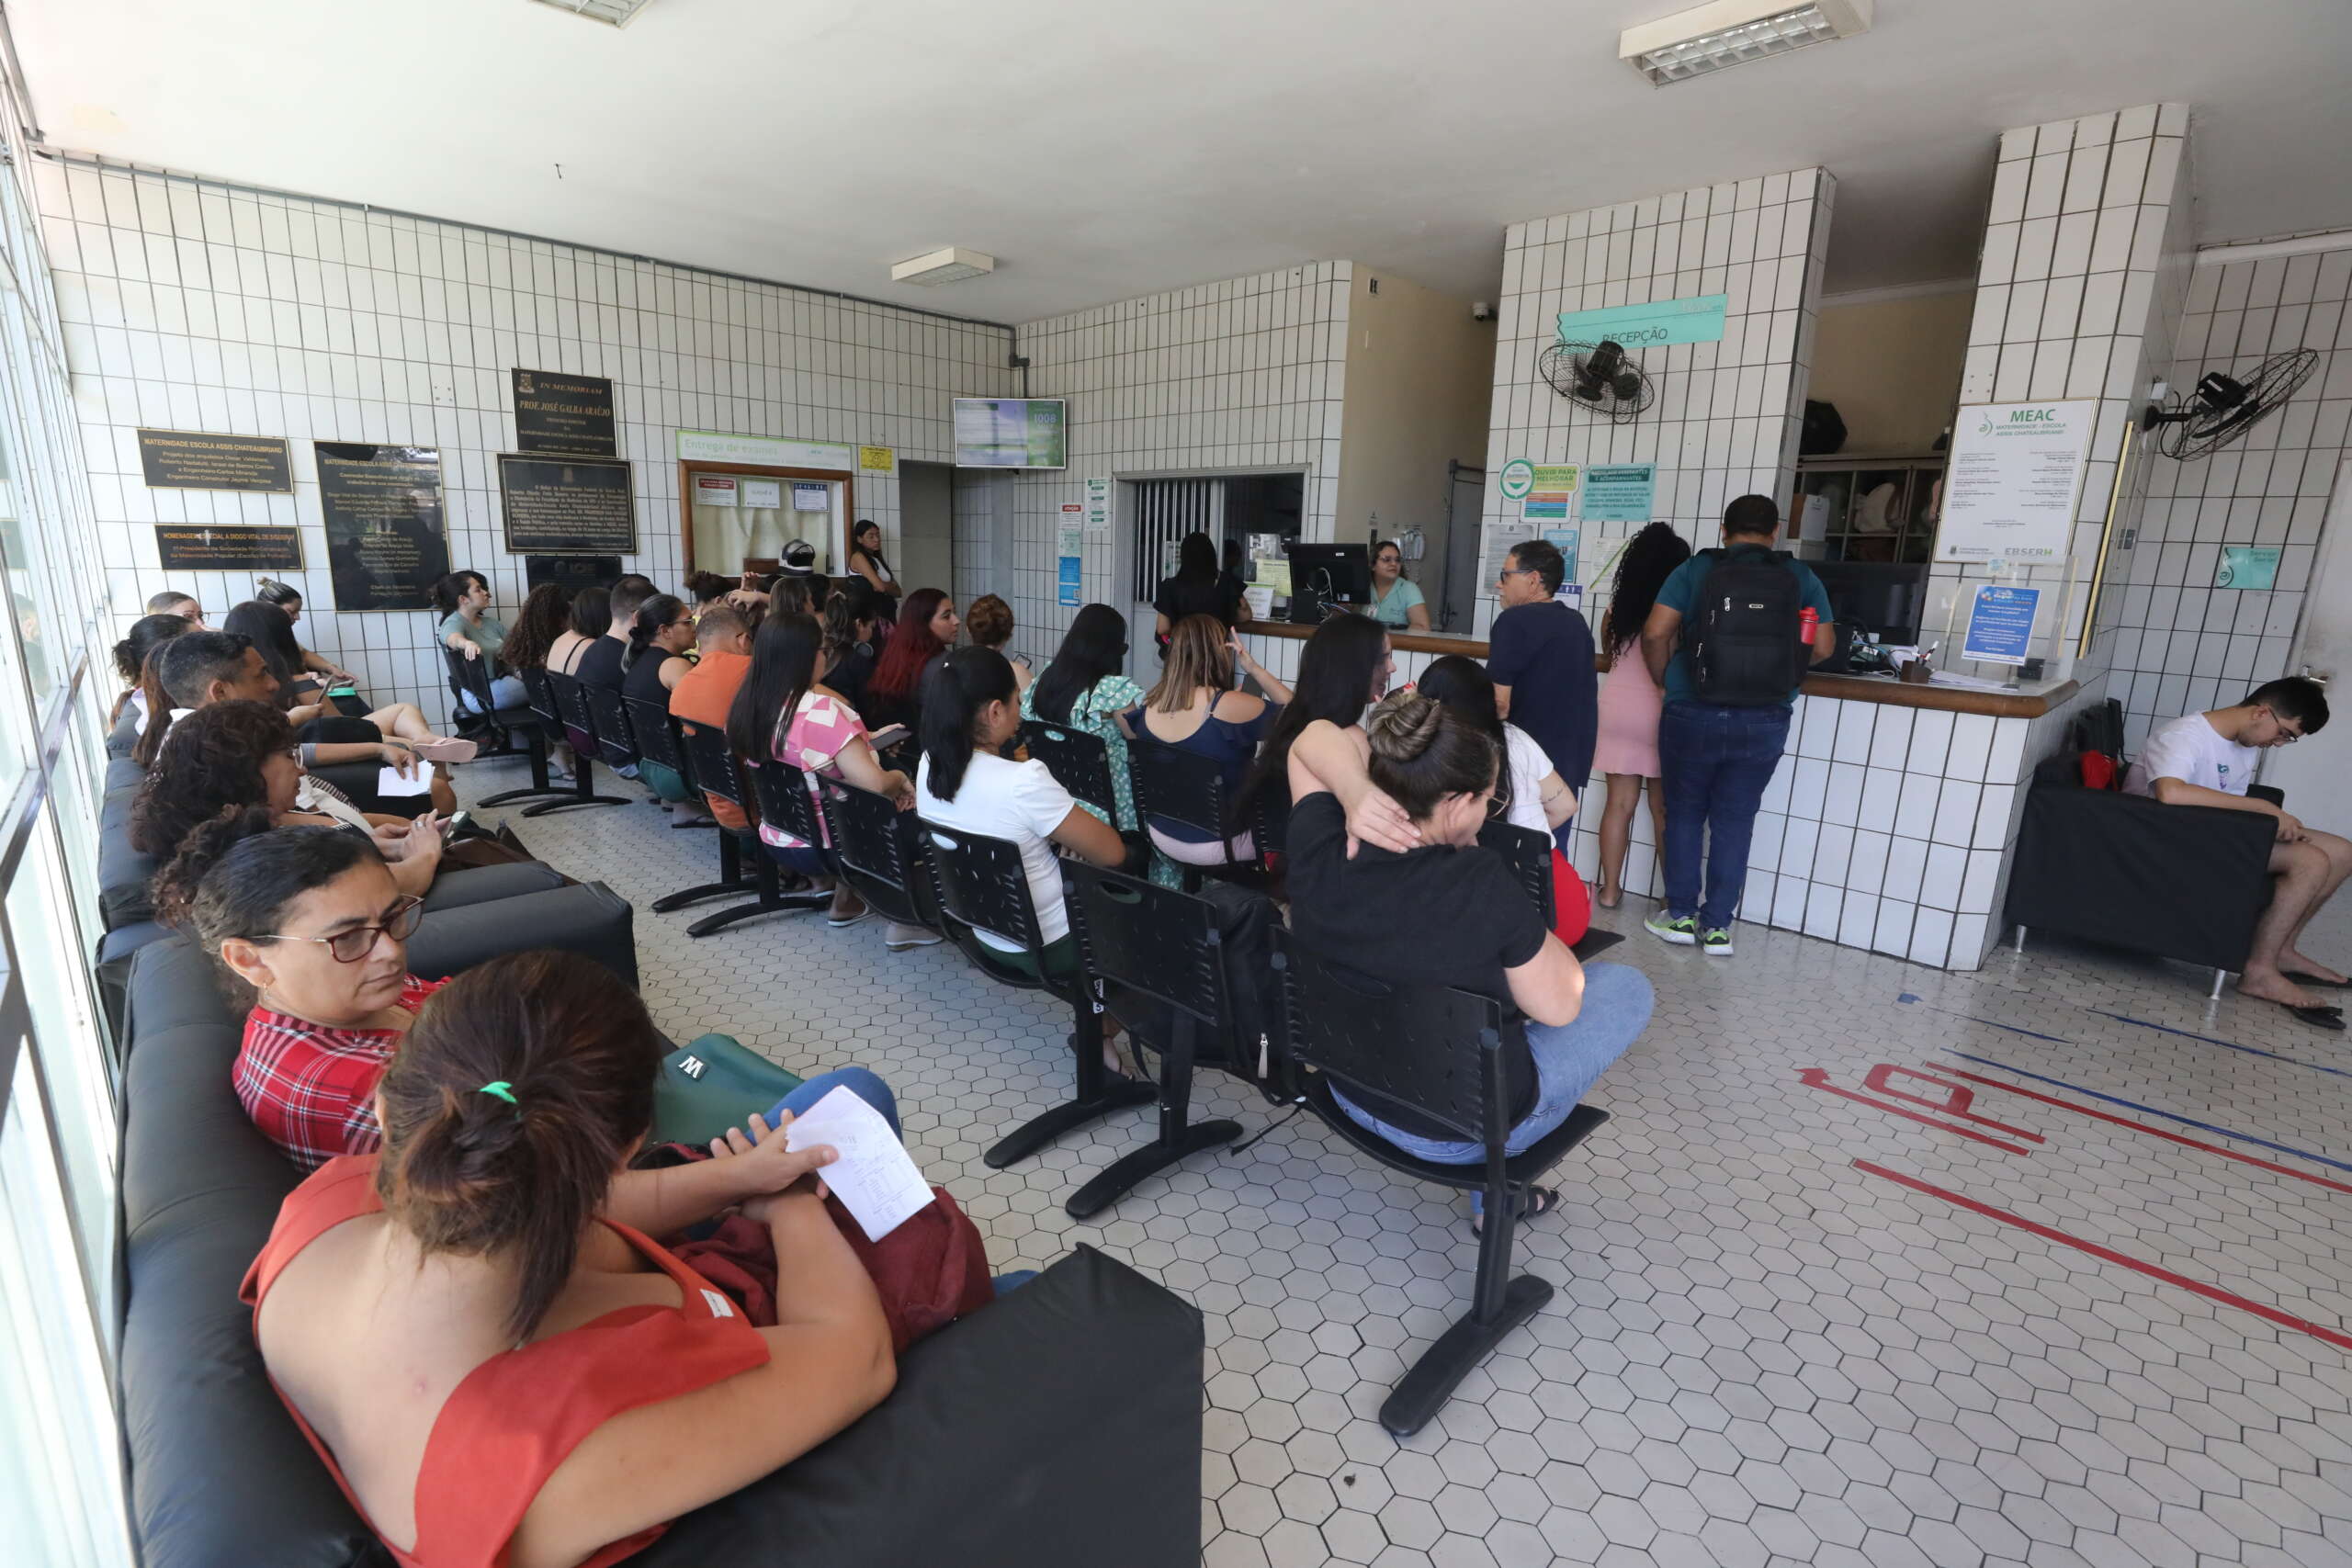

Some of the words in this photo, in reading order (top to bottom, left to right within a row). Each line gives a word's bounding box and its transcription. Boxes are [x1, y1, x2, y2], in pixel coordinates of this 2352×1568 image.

[520, 400, 540, 411] PROF.
[540, 401, 559, 412] JOSÉ
[2010, 409, 2056, 423] MEAC
[143, 438, 188, 447] MATERNIDADE
[190, 441, 214, 449] ESCOLA
[216, 443, 233, 451] ASSIS
[234, 444, 283, 454] CHATEAUBRIAND
[684, 438, 725, 453] Entrega
[727, 441, 738, 452] de
[741, 445, 778, 456] exames
[2005, 547, 2052, 557] EBSERH
